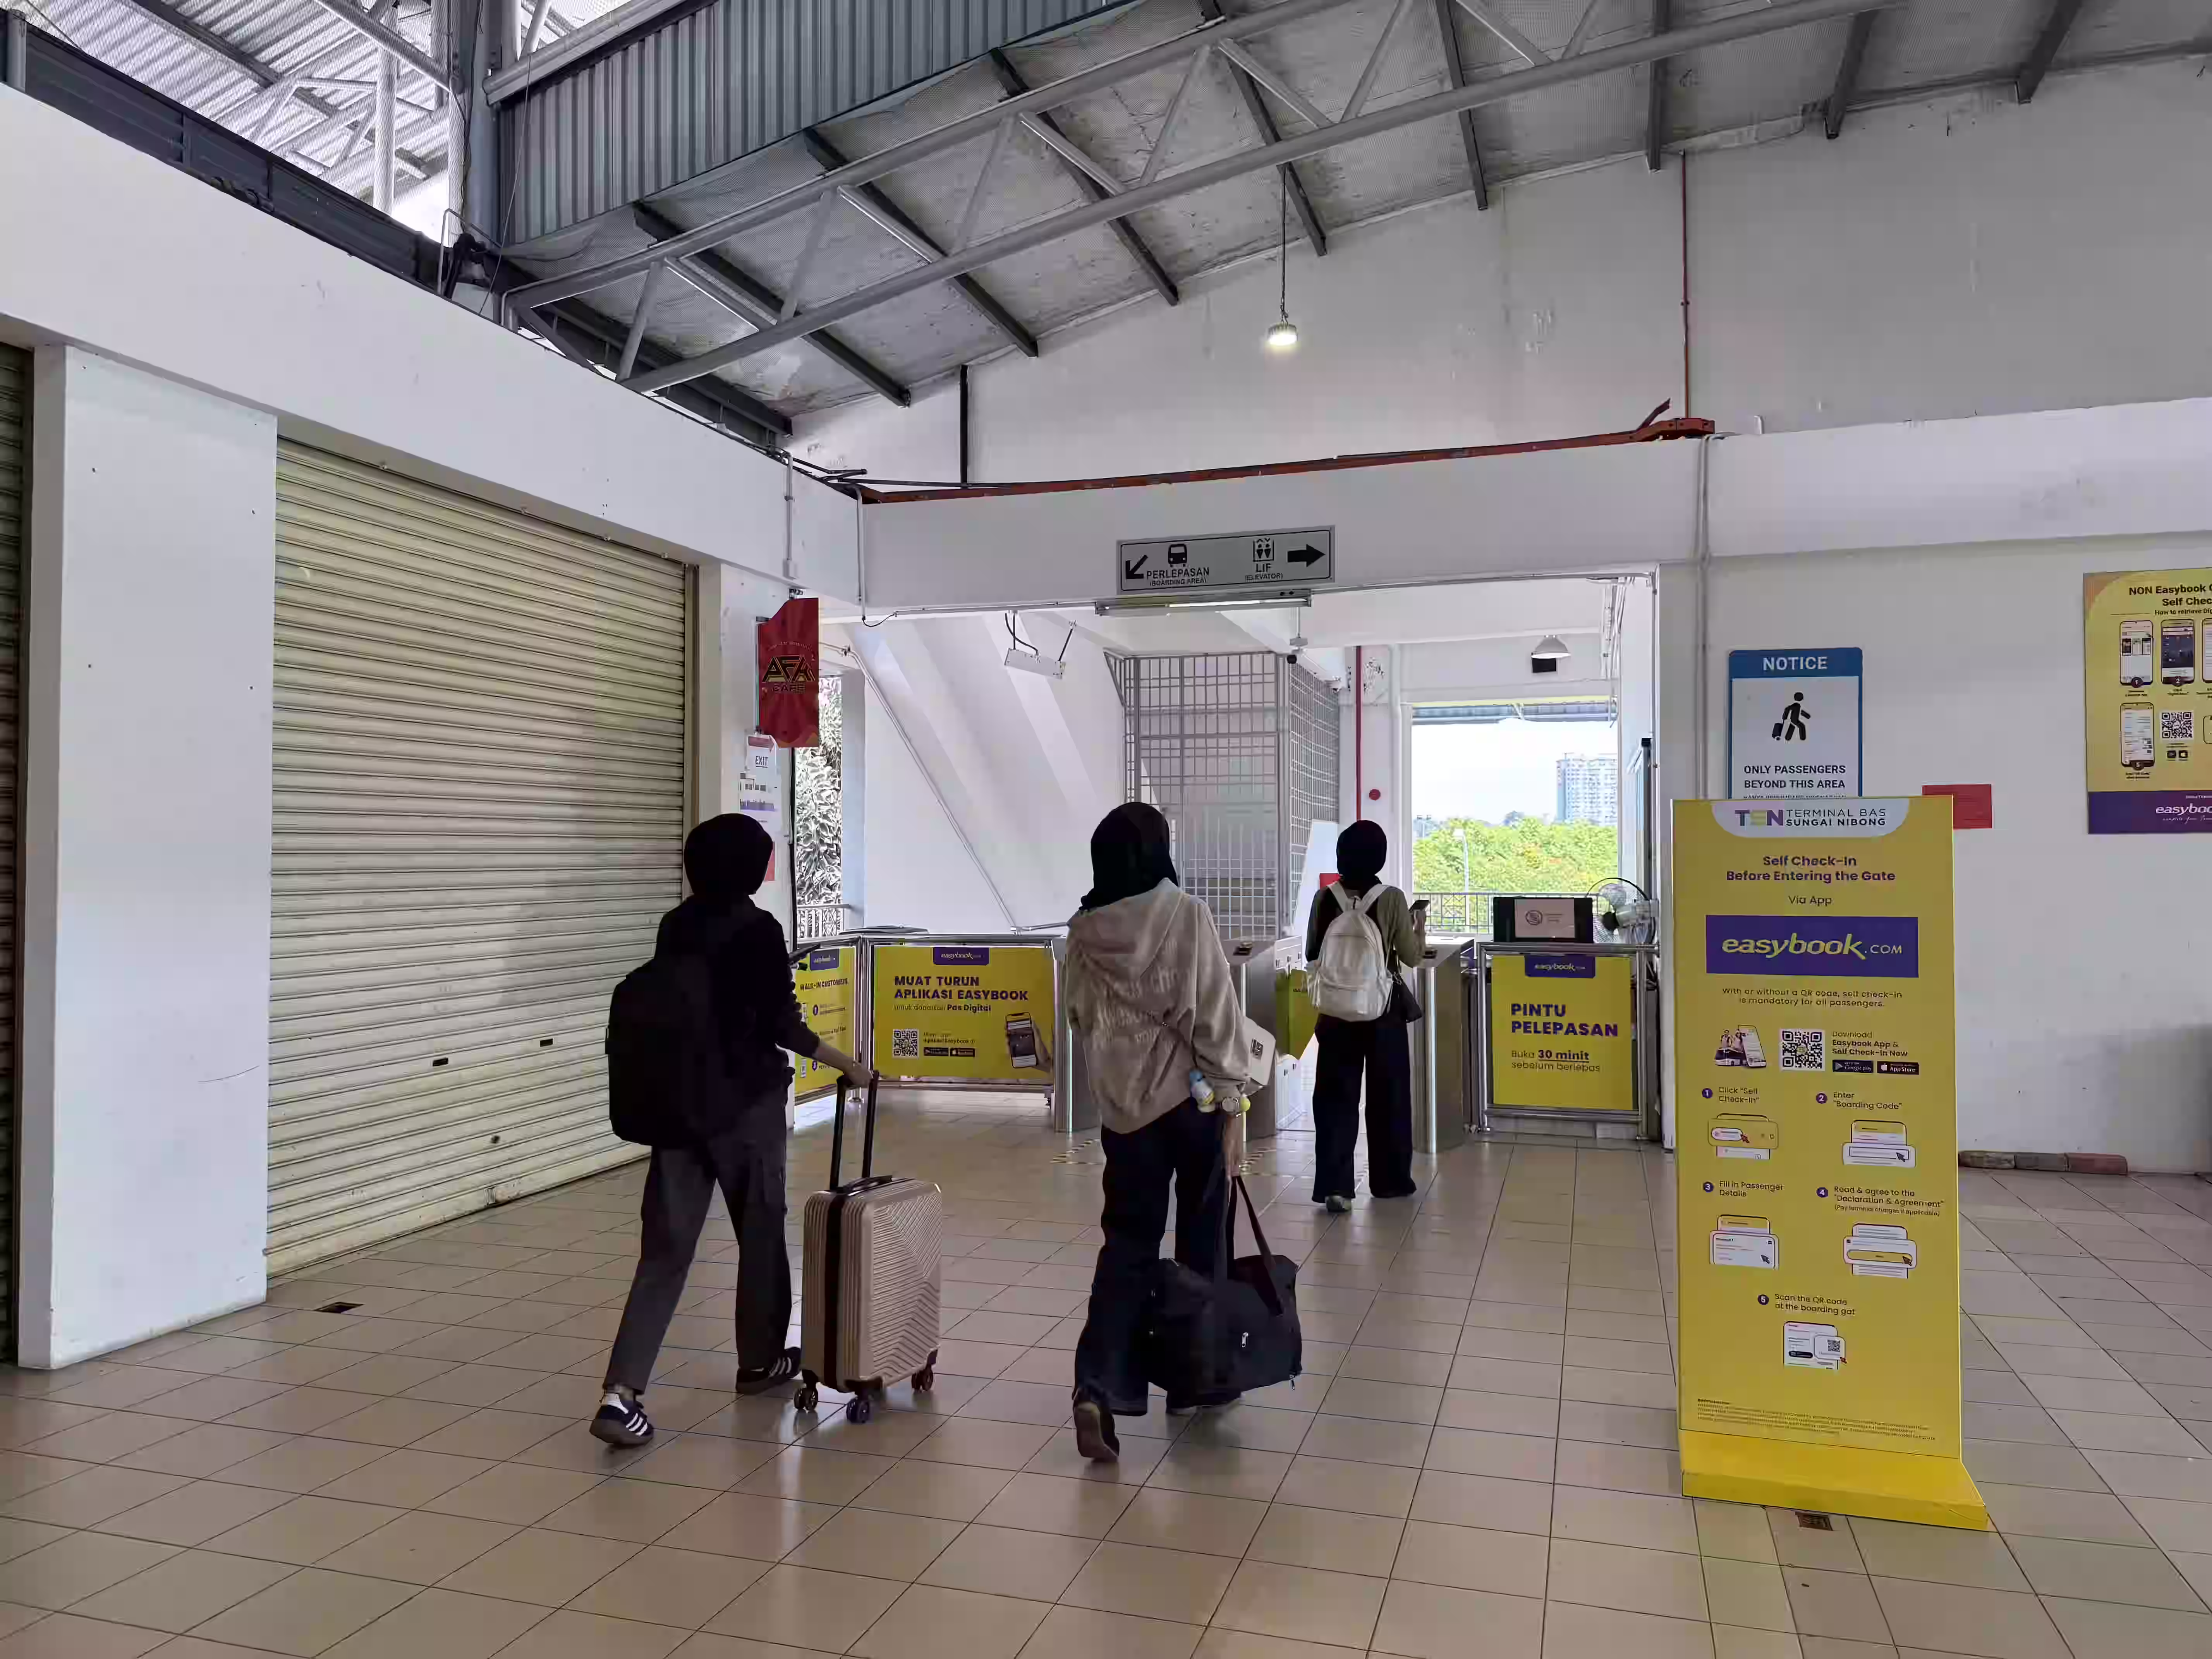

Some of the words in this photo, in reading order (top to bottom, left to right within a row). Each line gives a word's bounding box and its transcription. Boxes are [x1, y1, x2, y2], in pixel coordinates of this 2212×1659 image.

[1256, 563, 1271, 572] LIF
[1147, 567, 1209, 579] PERLEPASAN
[1245, 573, 1283, 581] (ELEVATOR)
[2129, 586, 2152, 595] NON
[2156, 584, 2206, 595] Easybook
[2162, 598, 2183, 606] Self
[1763, 657, 1827, 670] NOTICE
[756, 756, 768, 766] EXIT
[1744, 765, 1771, 774] ONLY
[1775, 765, 1846, 774] PASSENGERS
[1744, 780, 1786, 788] BEYOND
[1789, 780, 1814, 788] THIS
[1817, 780, 1845, 788] AREA
[1763, 856, 1788, 866] Self
[1791, 856, 1856, 866] Check-In
[1726, 871, 1770, 880] Before
[1774, 871, 1831, 883] Entering
[1836, 871, 1858, 880] the
[1862, 871, 1896, 881] Gate
[1788, 896, 1806, 904] Via
[1810, 896, 1832, 906] App
[895, 976, 931, 986] MUAT
[936, 976, 979, 986] TURUN
[895, 989, 952, 999] APLIKASI
[958, 990, 1028, 1000] EASYBOOK
[1749, 998, 1798, 1006] mandatory
[964, 1004, 991, 1012] Digital
[1511, 1003, 1566, 1017] PINTU
[1511, 1021, 1618, 1037] PELEPASAN
[1538, 1050, 1552, 1058] 30
[1556, 1050, 1589, 1060] minit
[1557, 1063, 1599, 1072] berlepas
[1833, 1101, 1874, 1110] "Boarding
[1741, 1182, 1783, 1192] Passenger
[1801, 1304, 1838, 1315] boarding
